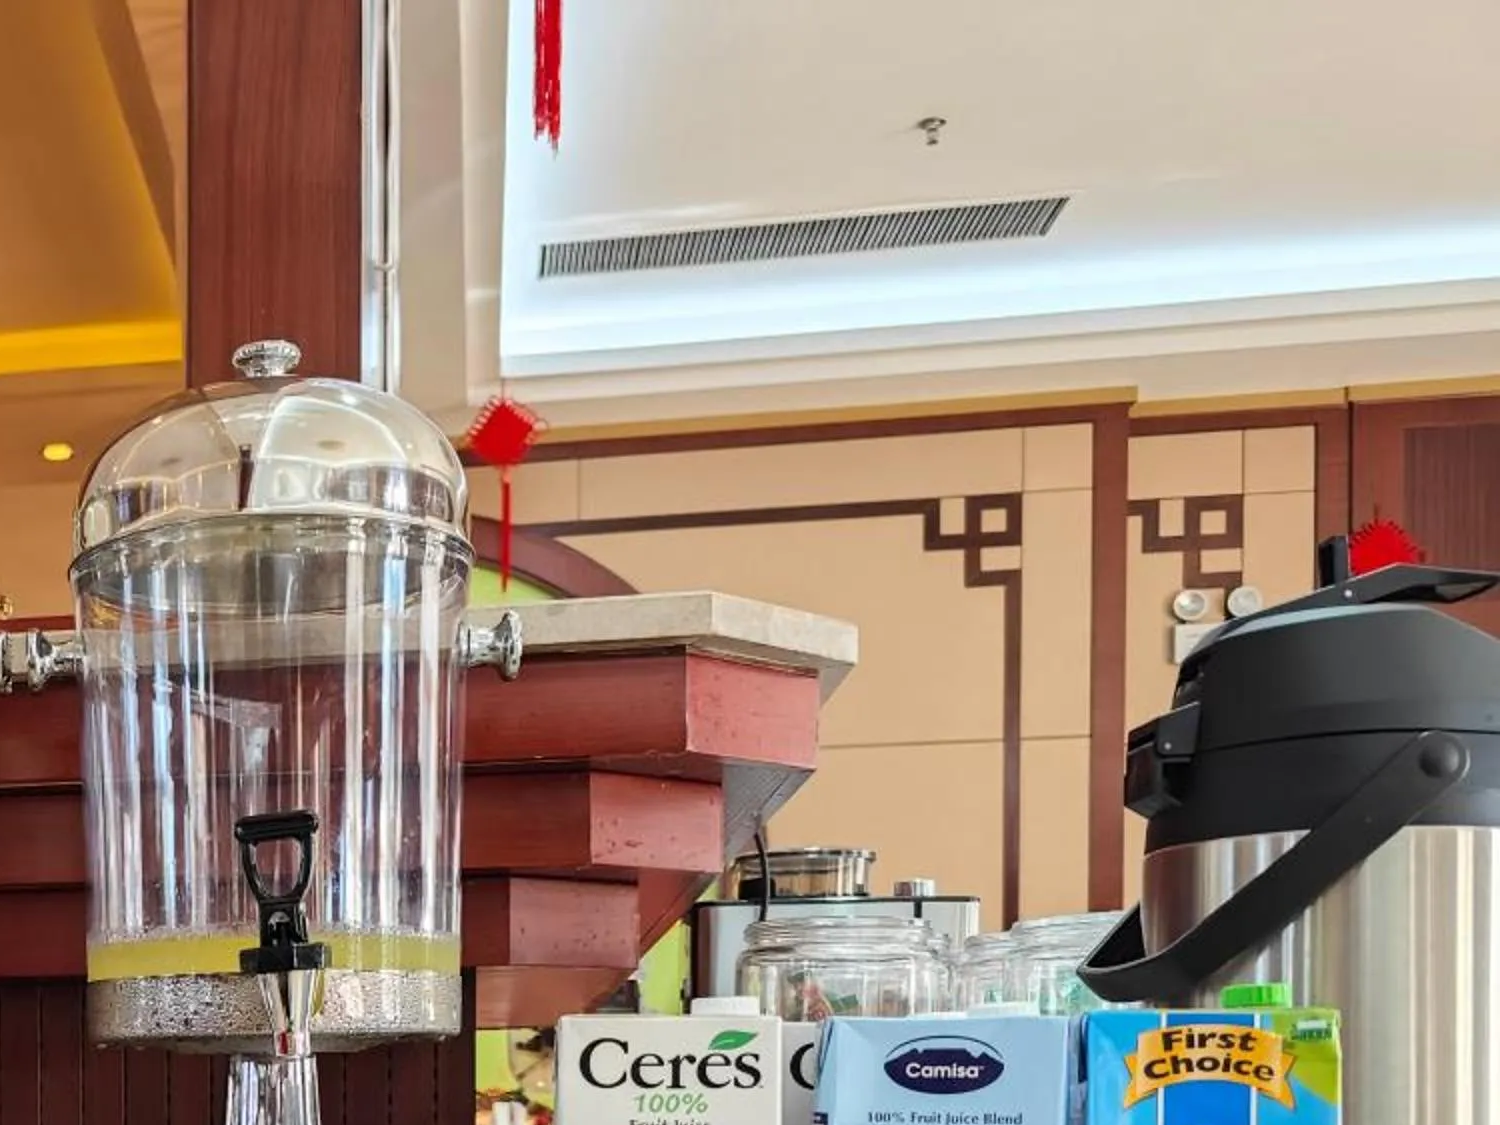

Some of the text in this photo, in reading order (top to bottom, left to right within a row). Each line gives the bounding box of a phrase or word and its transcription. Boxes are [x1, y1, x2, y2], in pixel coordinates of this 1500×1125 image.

[1161, 1028, 1257, 1052] First
[579, 1037, 762, 1089] Ceres
[905, 1062, 979, 1079] Camisa
[1143, 1053, 1275, 1082] Choice
[633, 1093, 709, 1115] 100%
[867, 1112, 905, 1124] 100%
[910, 1111, 941, 1125] Fruit
[983, 1113, 1023, 1125] Blend
